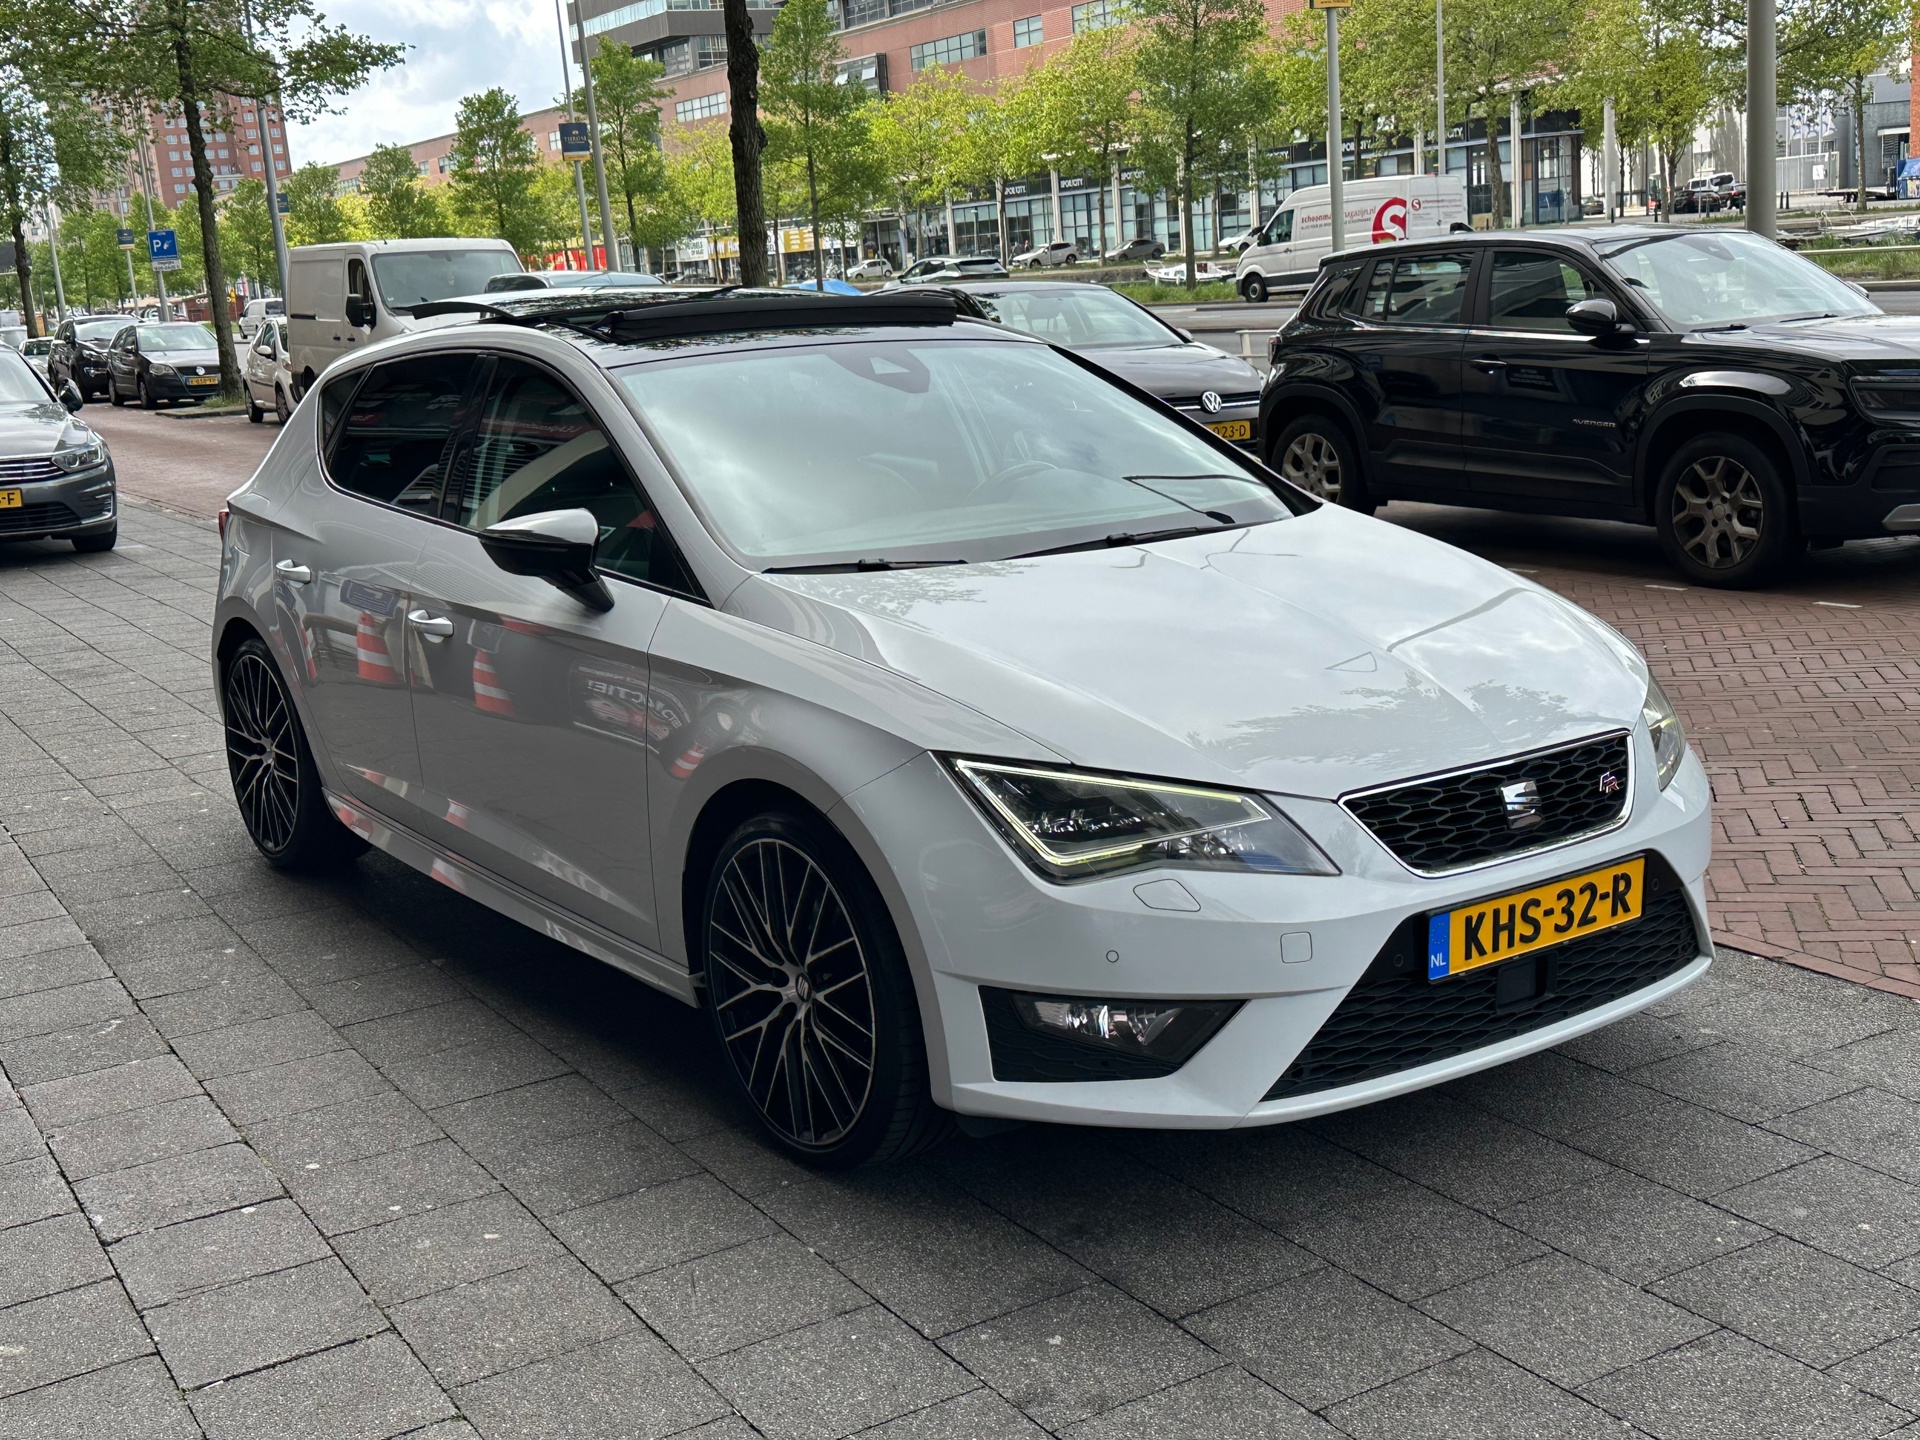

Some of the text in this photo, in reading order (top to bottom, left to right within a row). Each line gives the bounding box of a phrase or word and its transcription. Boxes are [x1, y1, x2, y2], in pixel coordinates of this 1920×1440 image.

[152, 239, 162, 253] P
[0, 492, 15, 505] -F
[1464, 872, 1633, 961] KHS-32-R
[1430, 953, 1446, 968] NL
